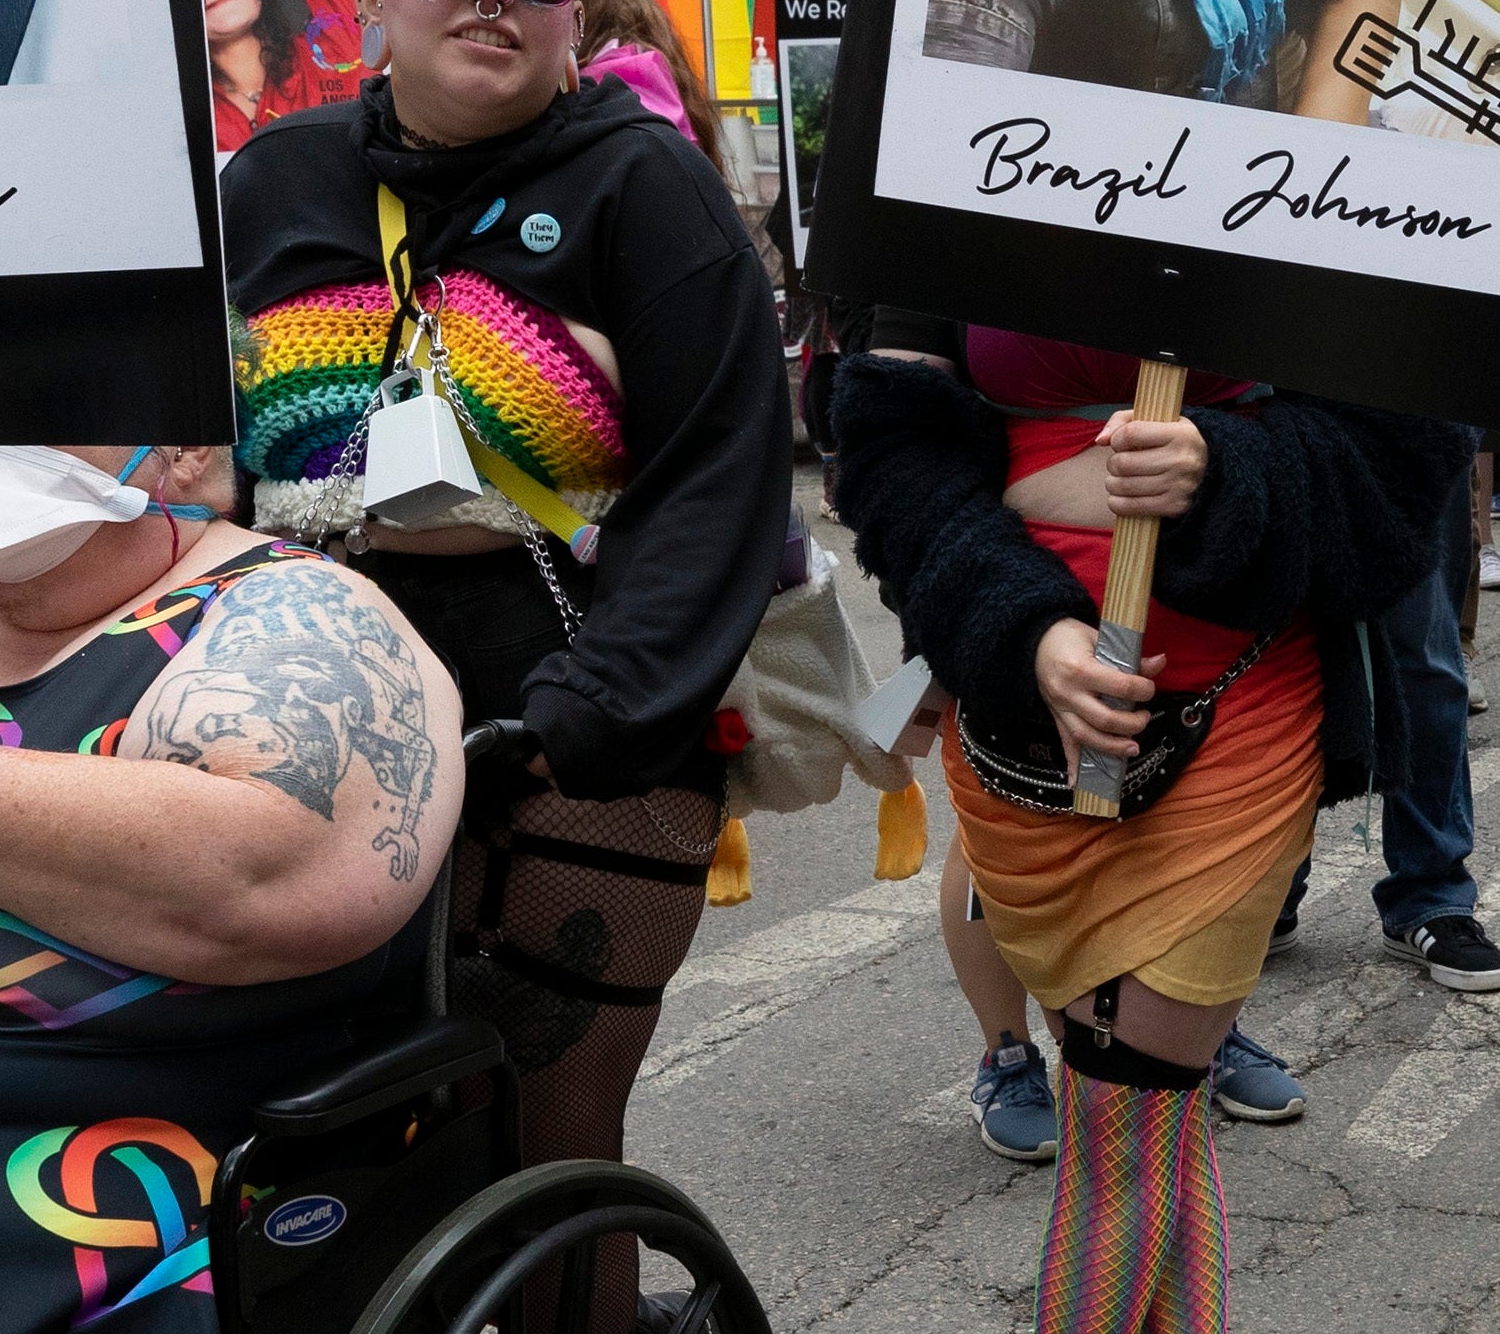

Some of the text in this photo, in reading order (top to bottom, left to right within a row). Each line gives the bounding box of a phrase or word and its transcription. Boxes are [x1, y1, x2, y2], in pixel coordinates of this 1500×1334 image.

[319, 80, 344, 92] LOS
[968, 117, 1492, 241] Brazil Johnson
[529, 222, 553, 234] They
[527, 232, 555, 244] Them
[275, 1204, 333, 1237] INVACARE
